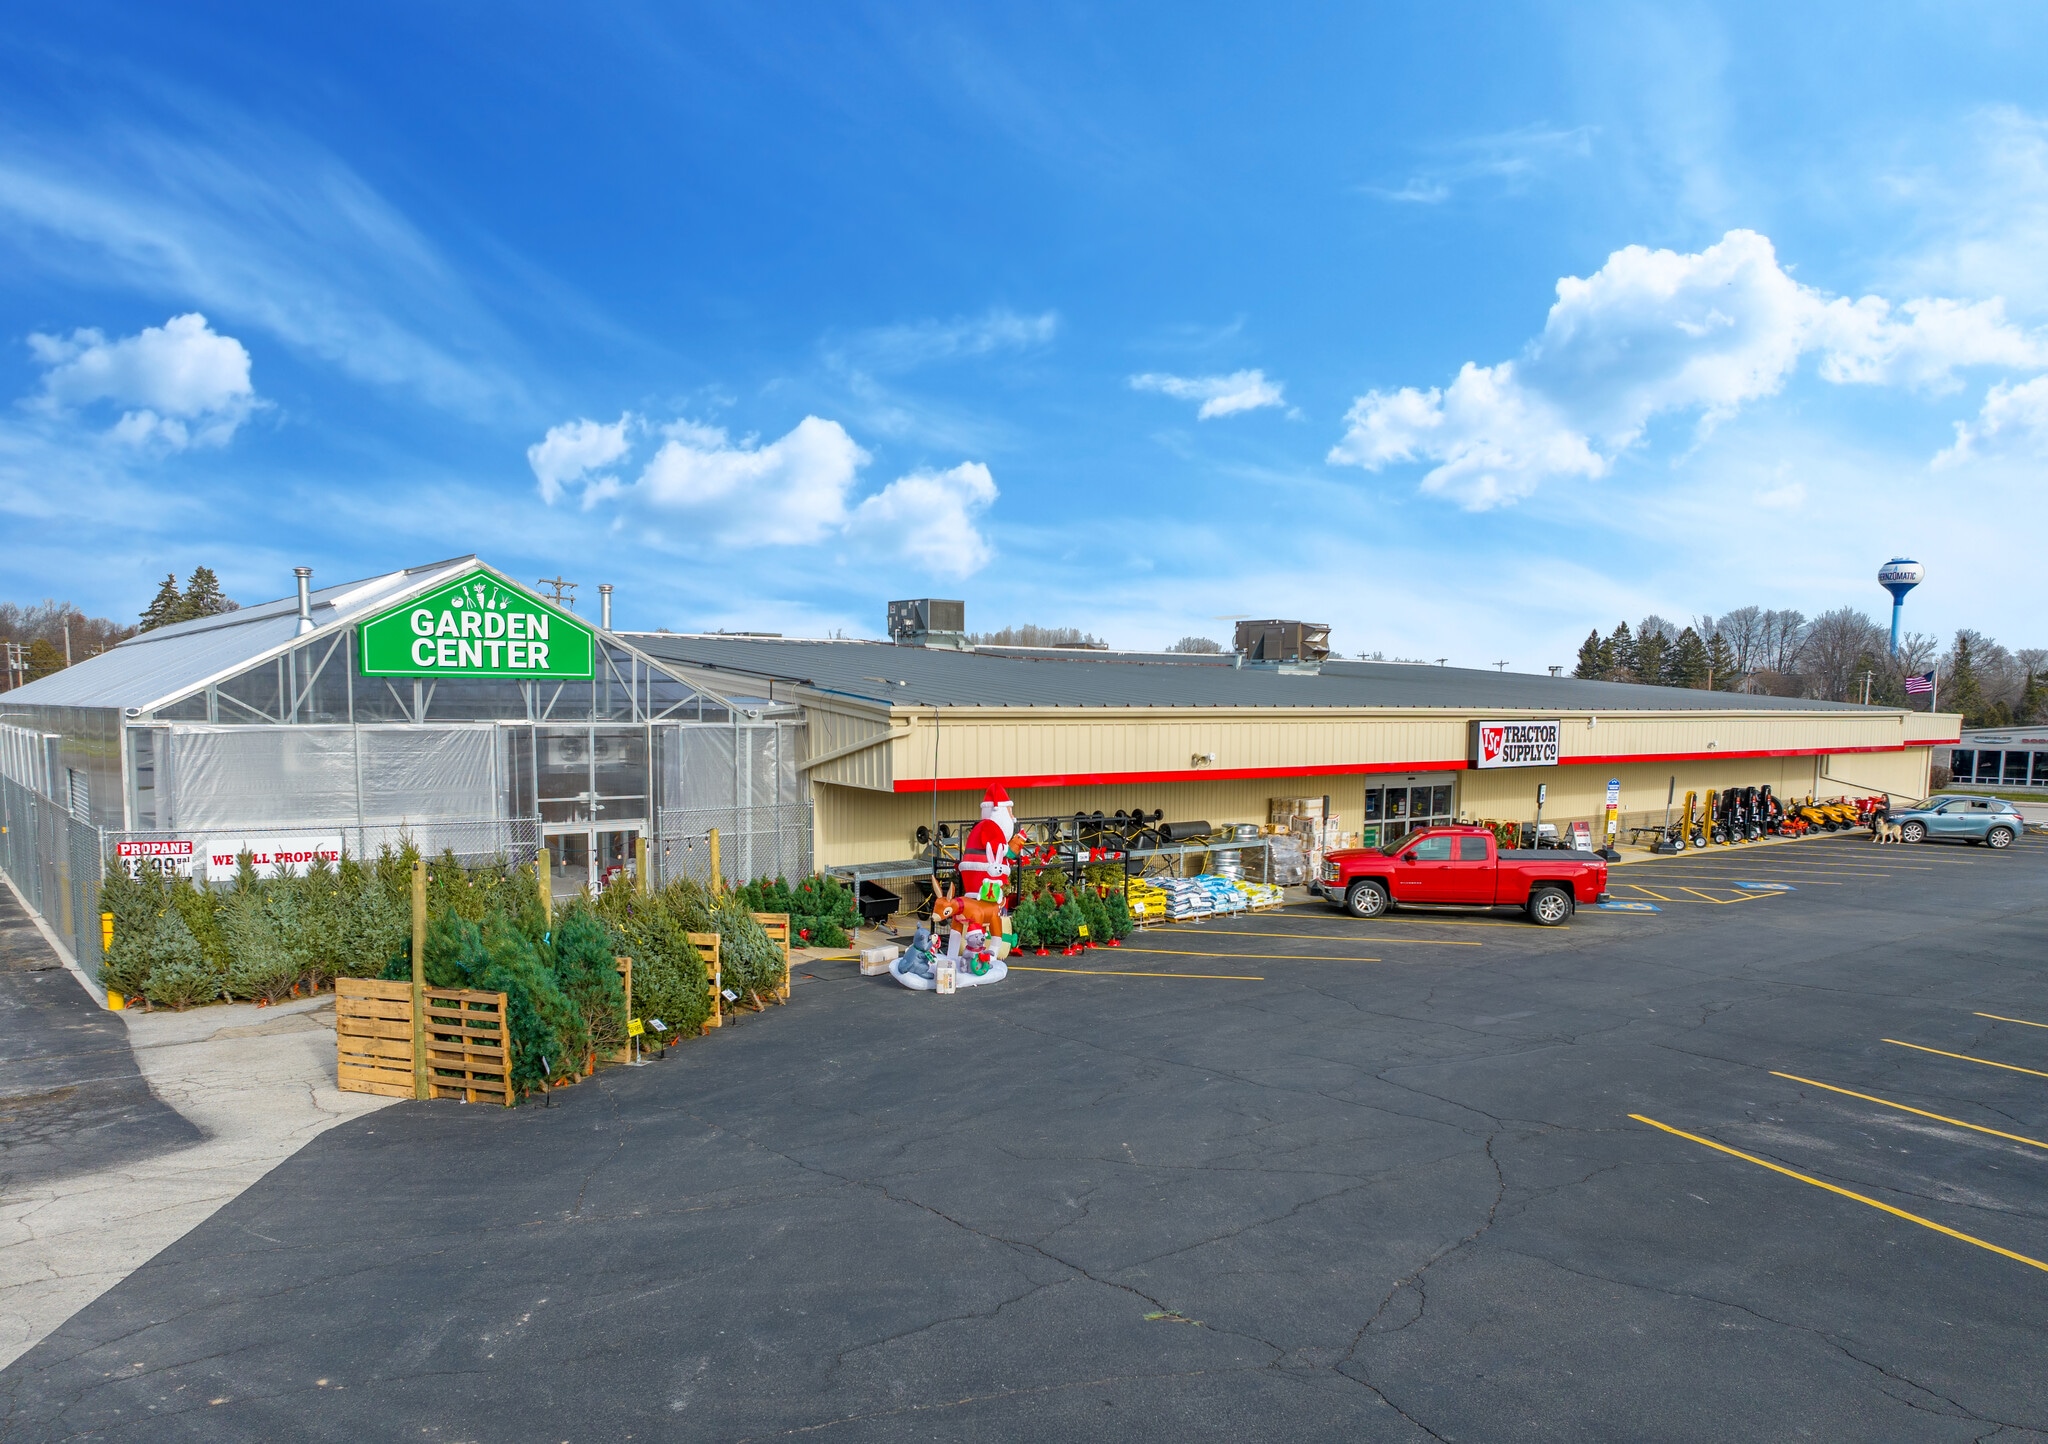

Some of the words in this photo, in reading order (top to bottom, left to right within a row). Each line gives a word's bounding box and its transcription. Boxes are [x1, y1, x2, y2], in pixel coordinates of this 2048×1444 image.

[410, 608, 550, 640] GARDEN
[411, 638, 550, 669] CENTER
[1483, 728, 1500, 755] TSC
[1504, 726, 1556, 743] TRACTOR
[1502, 745, 1543, 762] SUPPLY
[120, 842, 190, 855] PROPANE
[212, 855, 234, 865] WE
